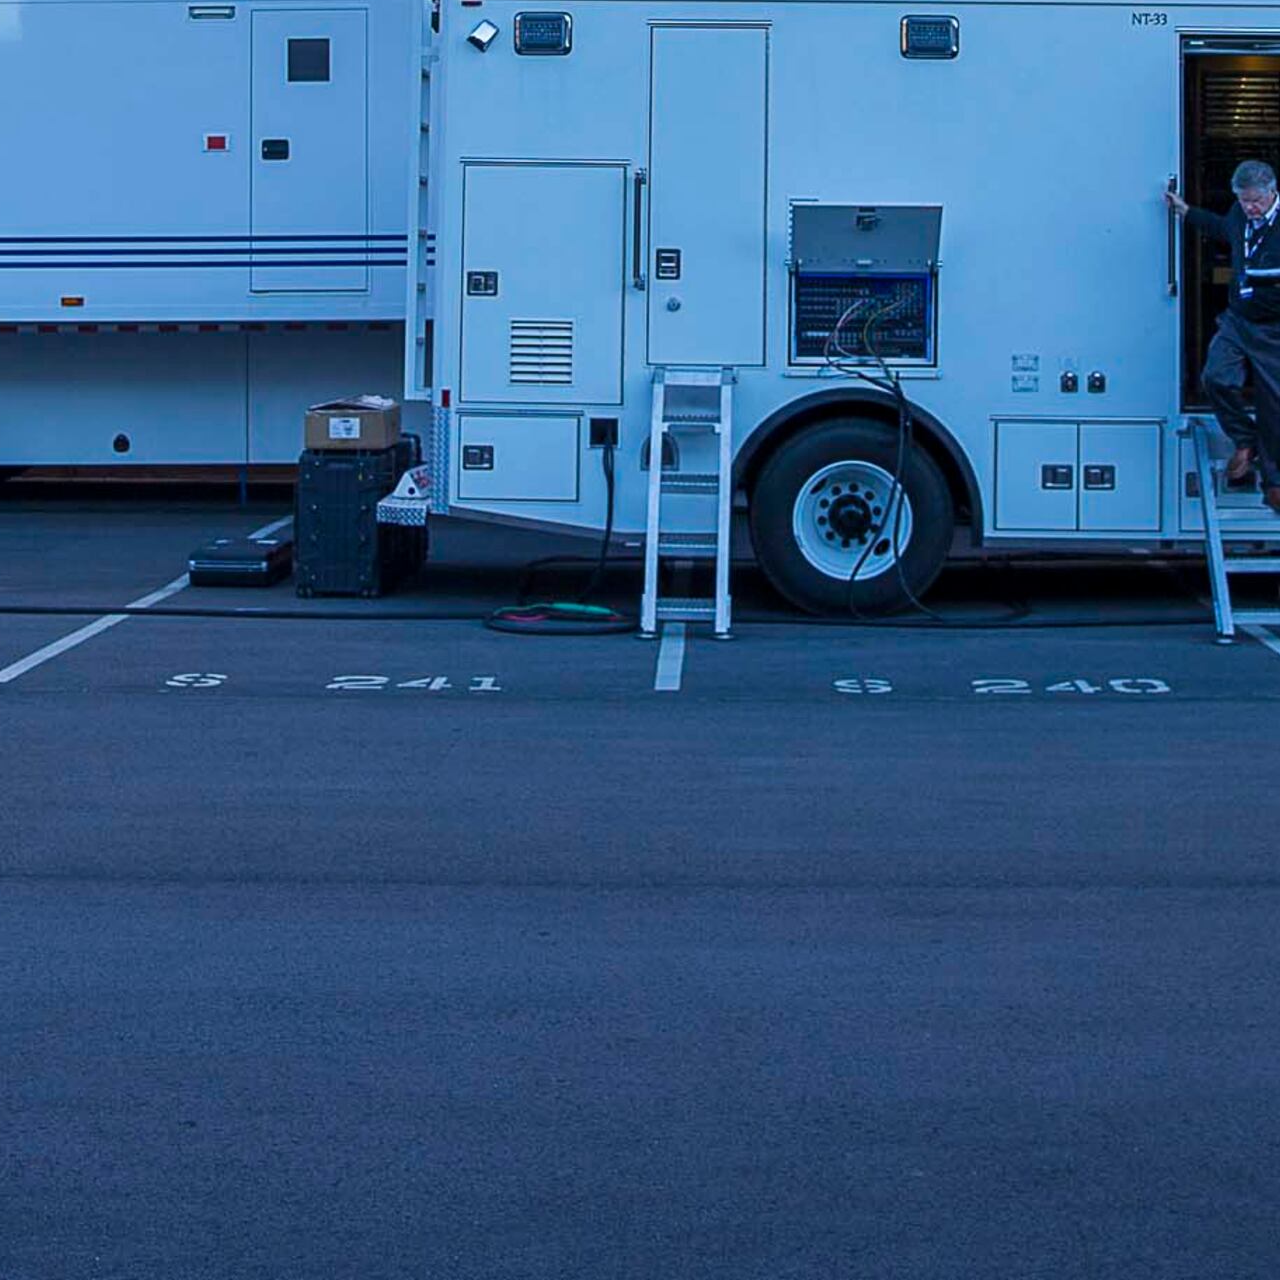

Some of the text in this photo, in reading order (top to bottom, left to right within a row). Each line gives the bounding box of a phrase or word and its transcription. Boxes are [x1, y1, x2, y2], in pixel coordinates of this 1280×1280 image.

[1131, 12, 1168, 26] NT-33
[325, 675, 502, 691] 241
[971, 678, 1171, 695] 240
